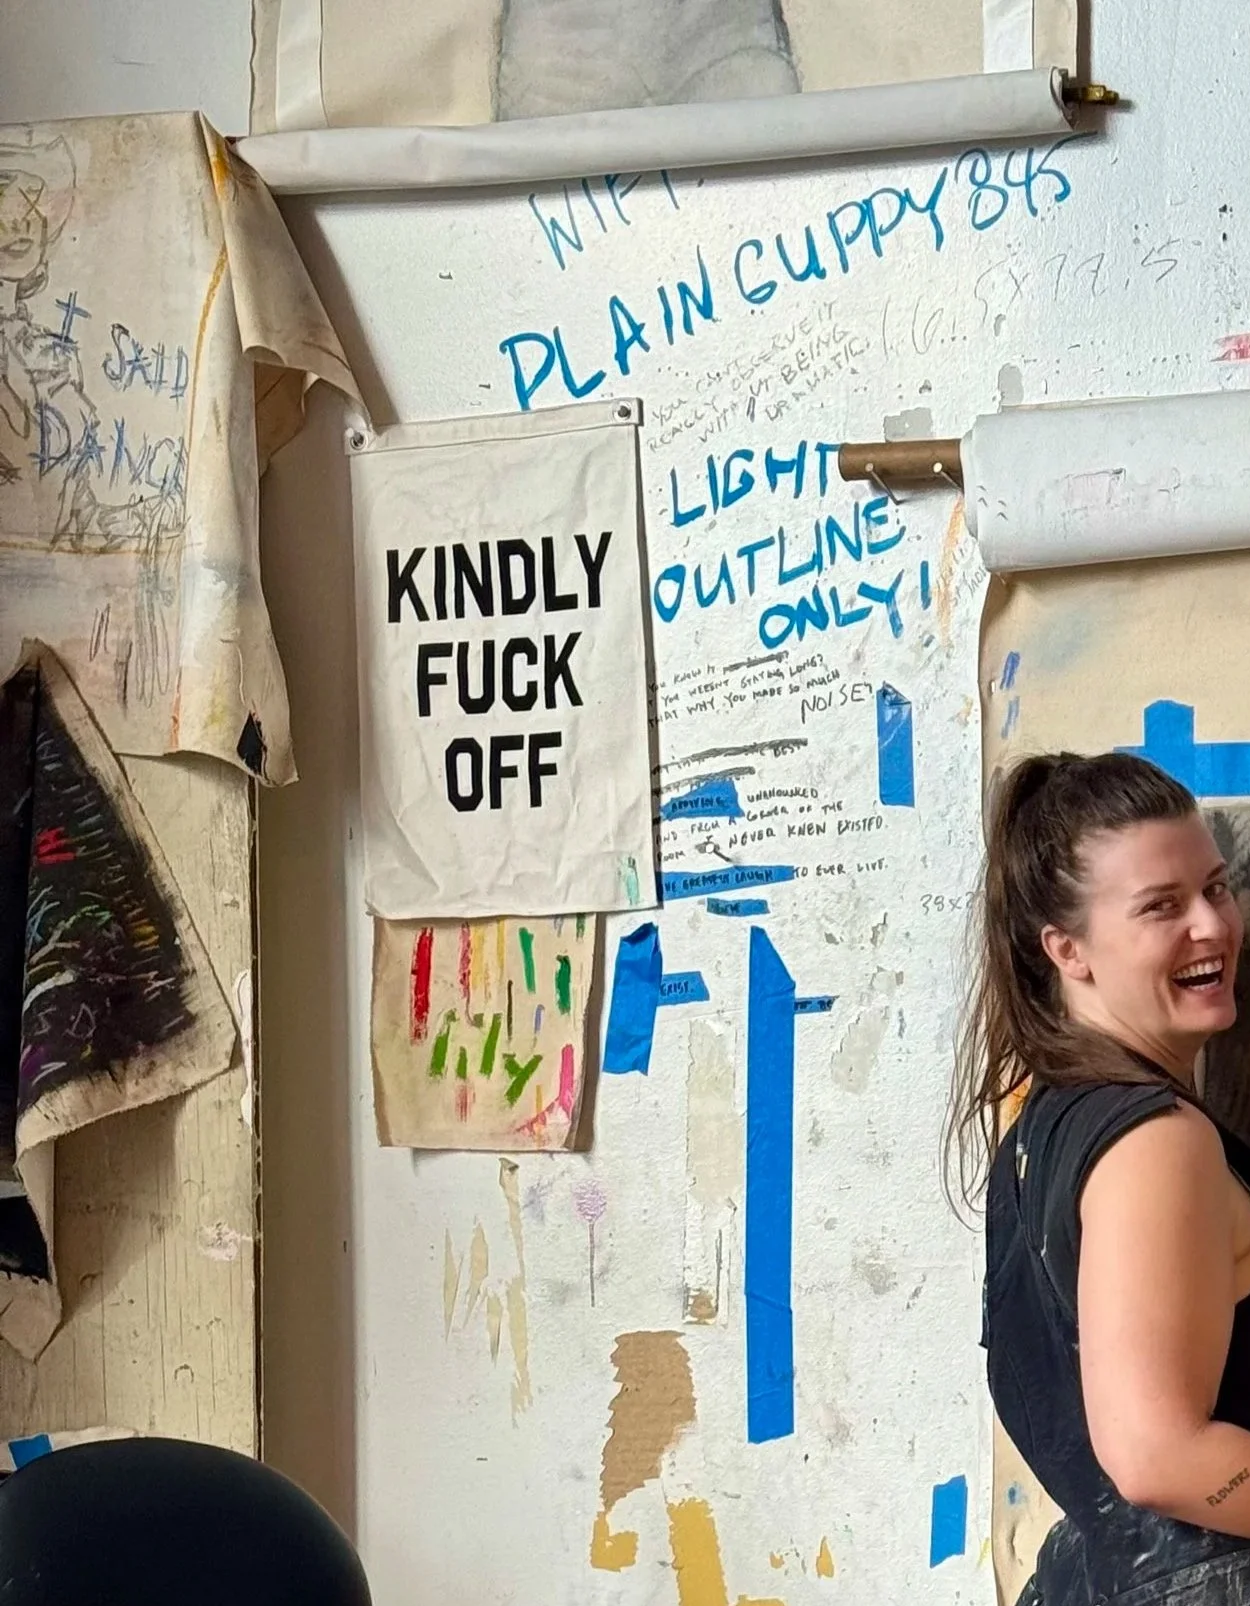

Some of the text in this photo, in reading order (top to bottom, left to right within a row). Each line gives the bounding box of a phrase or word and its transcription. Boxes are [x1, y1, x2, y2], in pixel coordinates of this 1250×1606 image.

[669, 440, 843, 528] LIGHT
[386, 531, 613, 623] KINDLY
[653, 496, 906, 622] OUTLINE
[758, 561, 932, 650] ONLY!
[416, 631, 584, 718] FUCK
[686, 697, 715, 715] WHY
[445, 731, 563, 812] OFF
